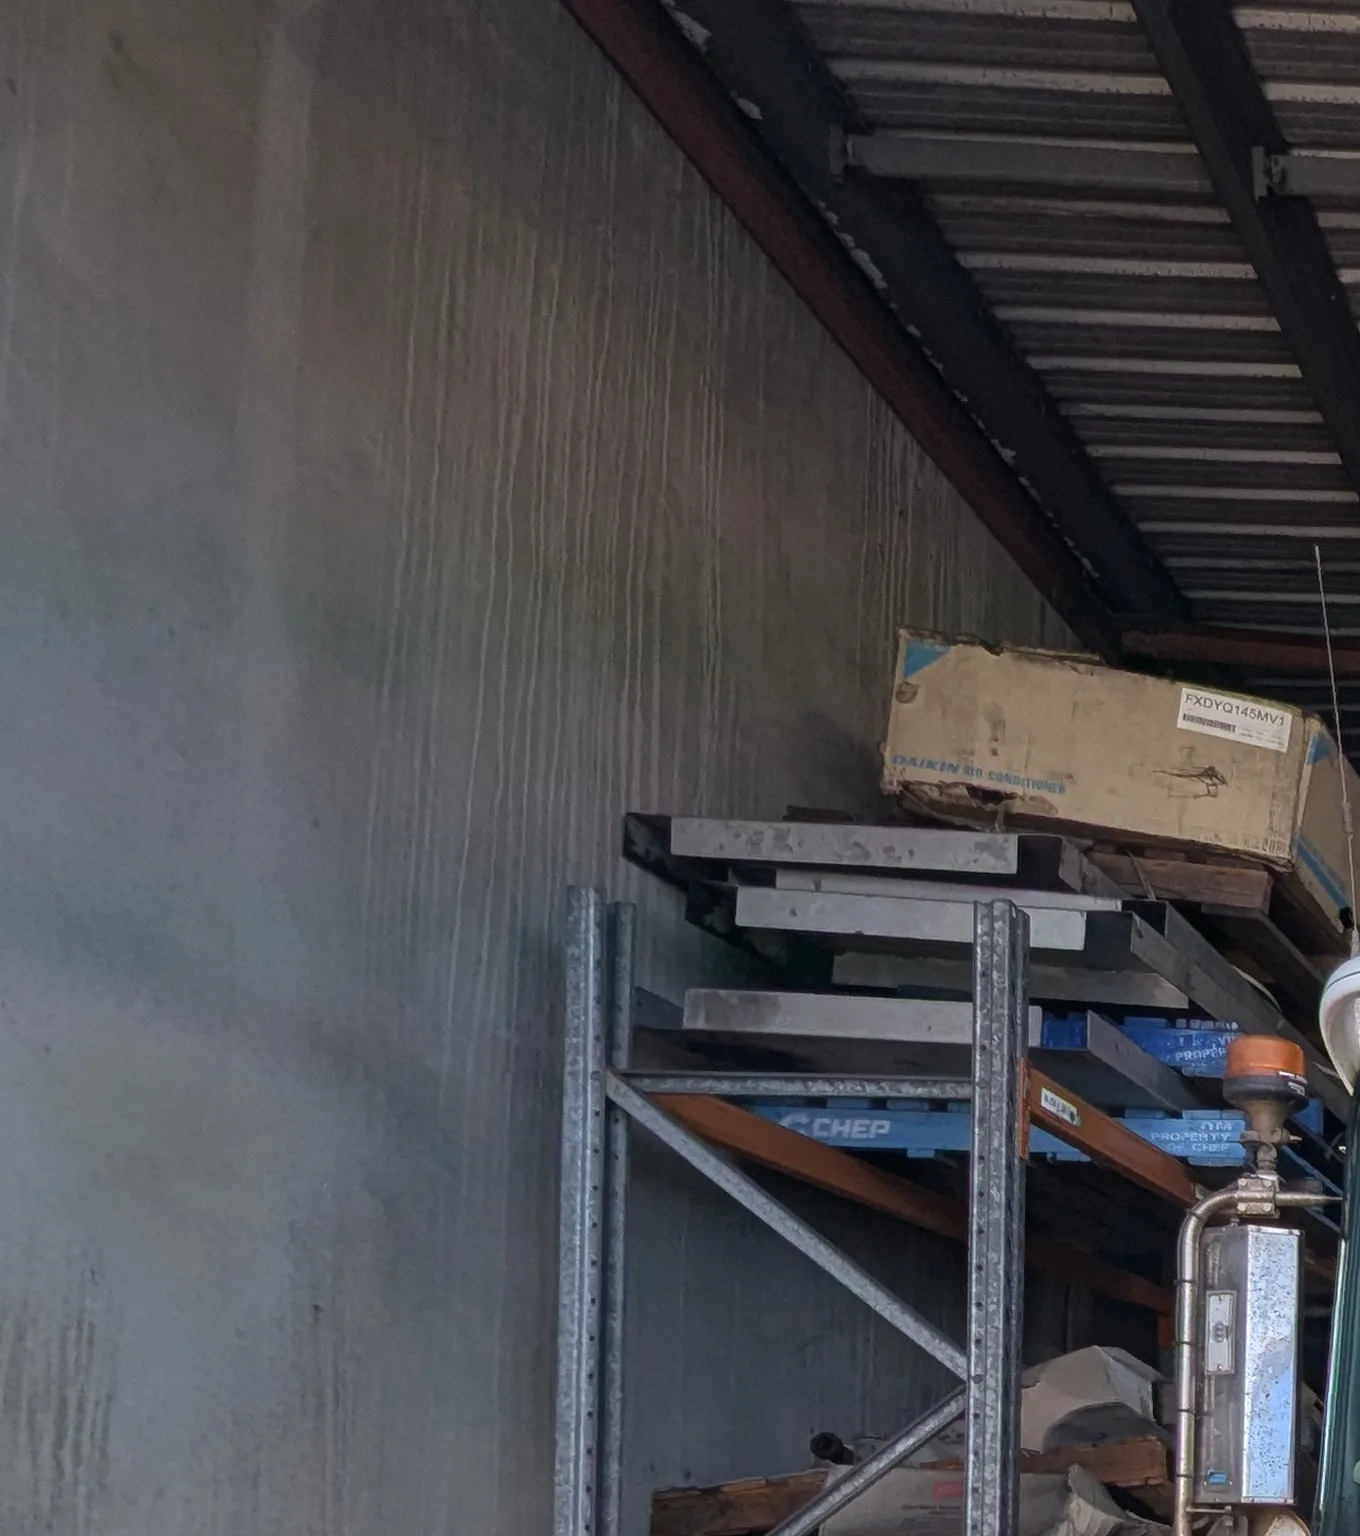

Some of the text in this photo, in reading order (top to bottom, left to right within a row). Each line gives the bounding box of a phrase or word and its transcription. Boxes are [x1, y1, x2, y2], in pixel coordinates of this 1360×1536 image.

[1184, 693, 1285, 727] FXDYQ145MV1
[892, 754, 961, 775] DAIKIN
[812, 1118, 891, 1138] CHEP
[1150, 1132, 1231, 1142] PROPERTY
